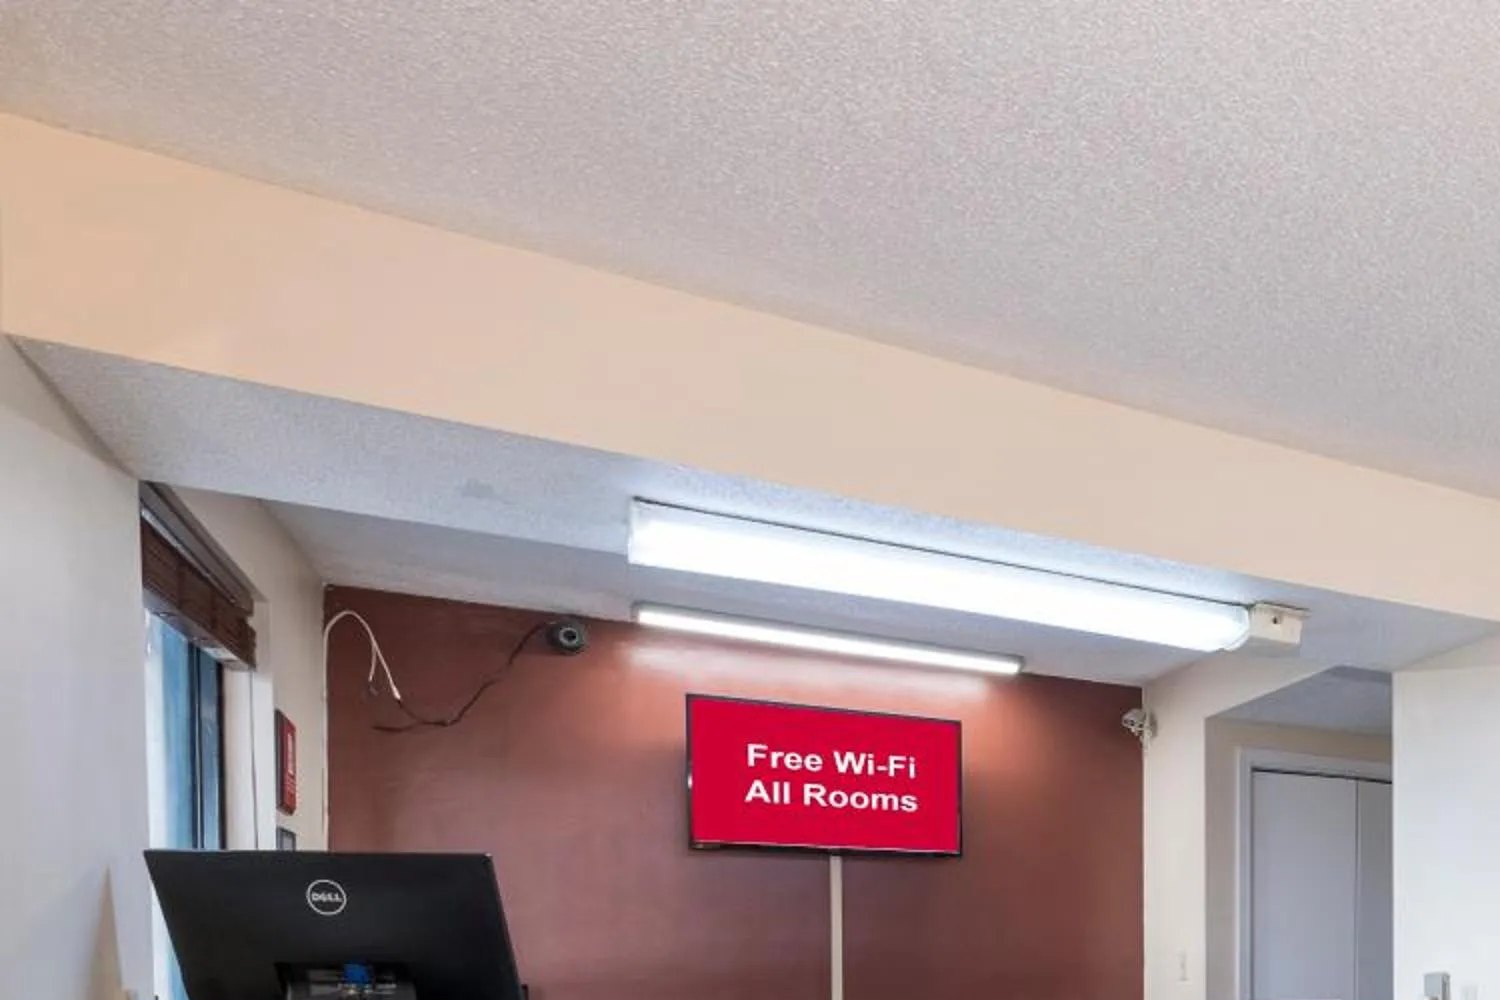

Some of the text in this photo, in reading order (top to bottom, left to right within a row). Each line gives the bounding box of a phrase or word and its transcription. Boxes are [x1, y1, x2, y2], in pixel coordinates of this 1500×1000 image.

[747, 743, 916, 779] Free Wi-Fi
[744, 780, 918, 812] All Rooms
[311, 892, 343, 902] DELL
